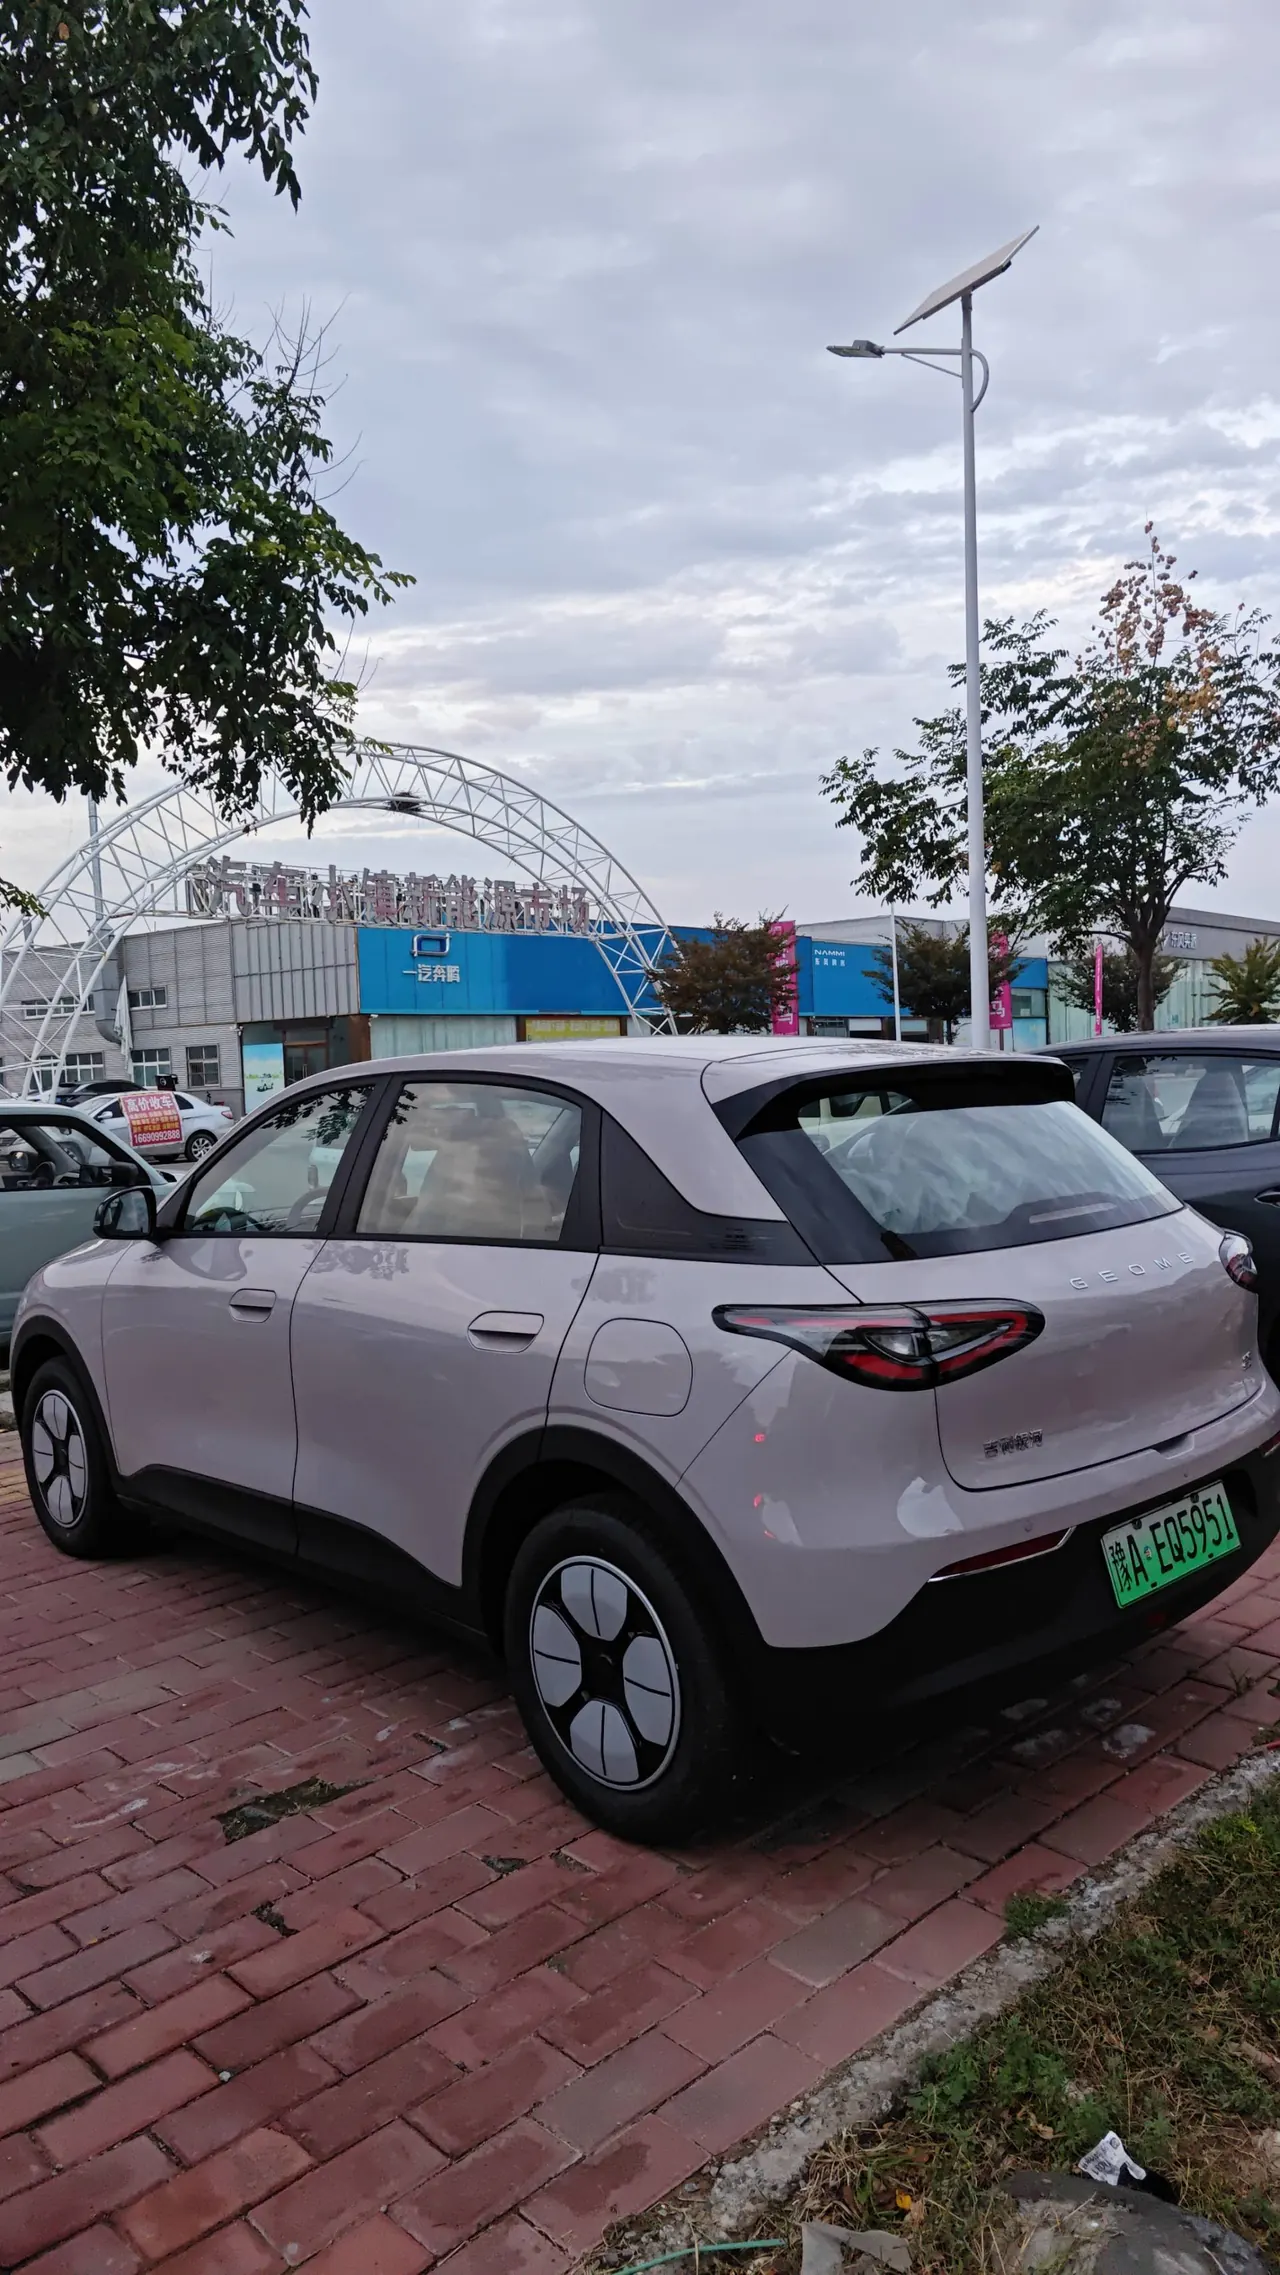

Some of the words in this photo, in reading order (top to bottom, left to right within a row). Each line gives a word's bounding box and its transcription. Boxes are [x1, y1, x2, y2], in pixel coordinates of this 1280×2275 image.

[814, 949, 845, 957] NAMMI
[402, 963, 461, 983] 一汽奔腾
[125, 1095, 173, 1113] 高价收车
[133, 1130, 181, 1144] 16690992888
[1069, 1252, 1194, 1290] GEOME
